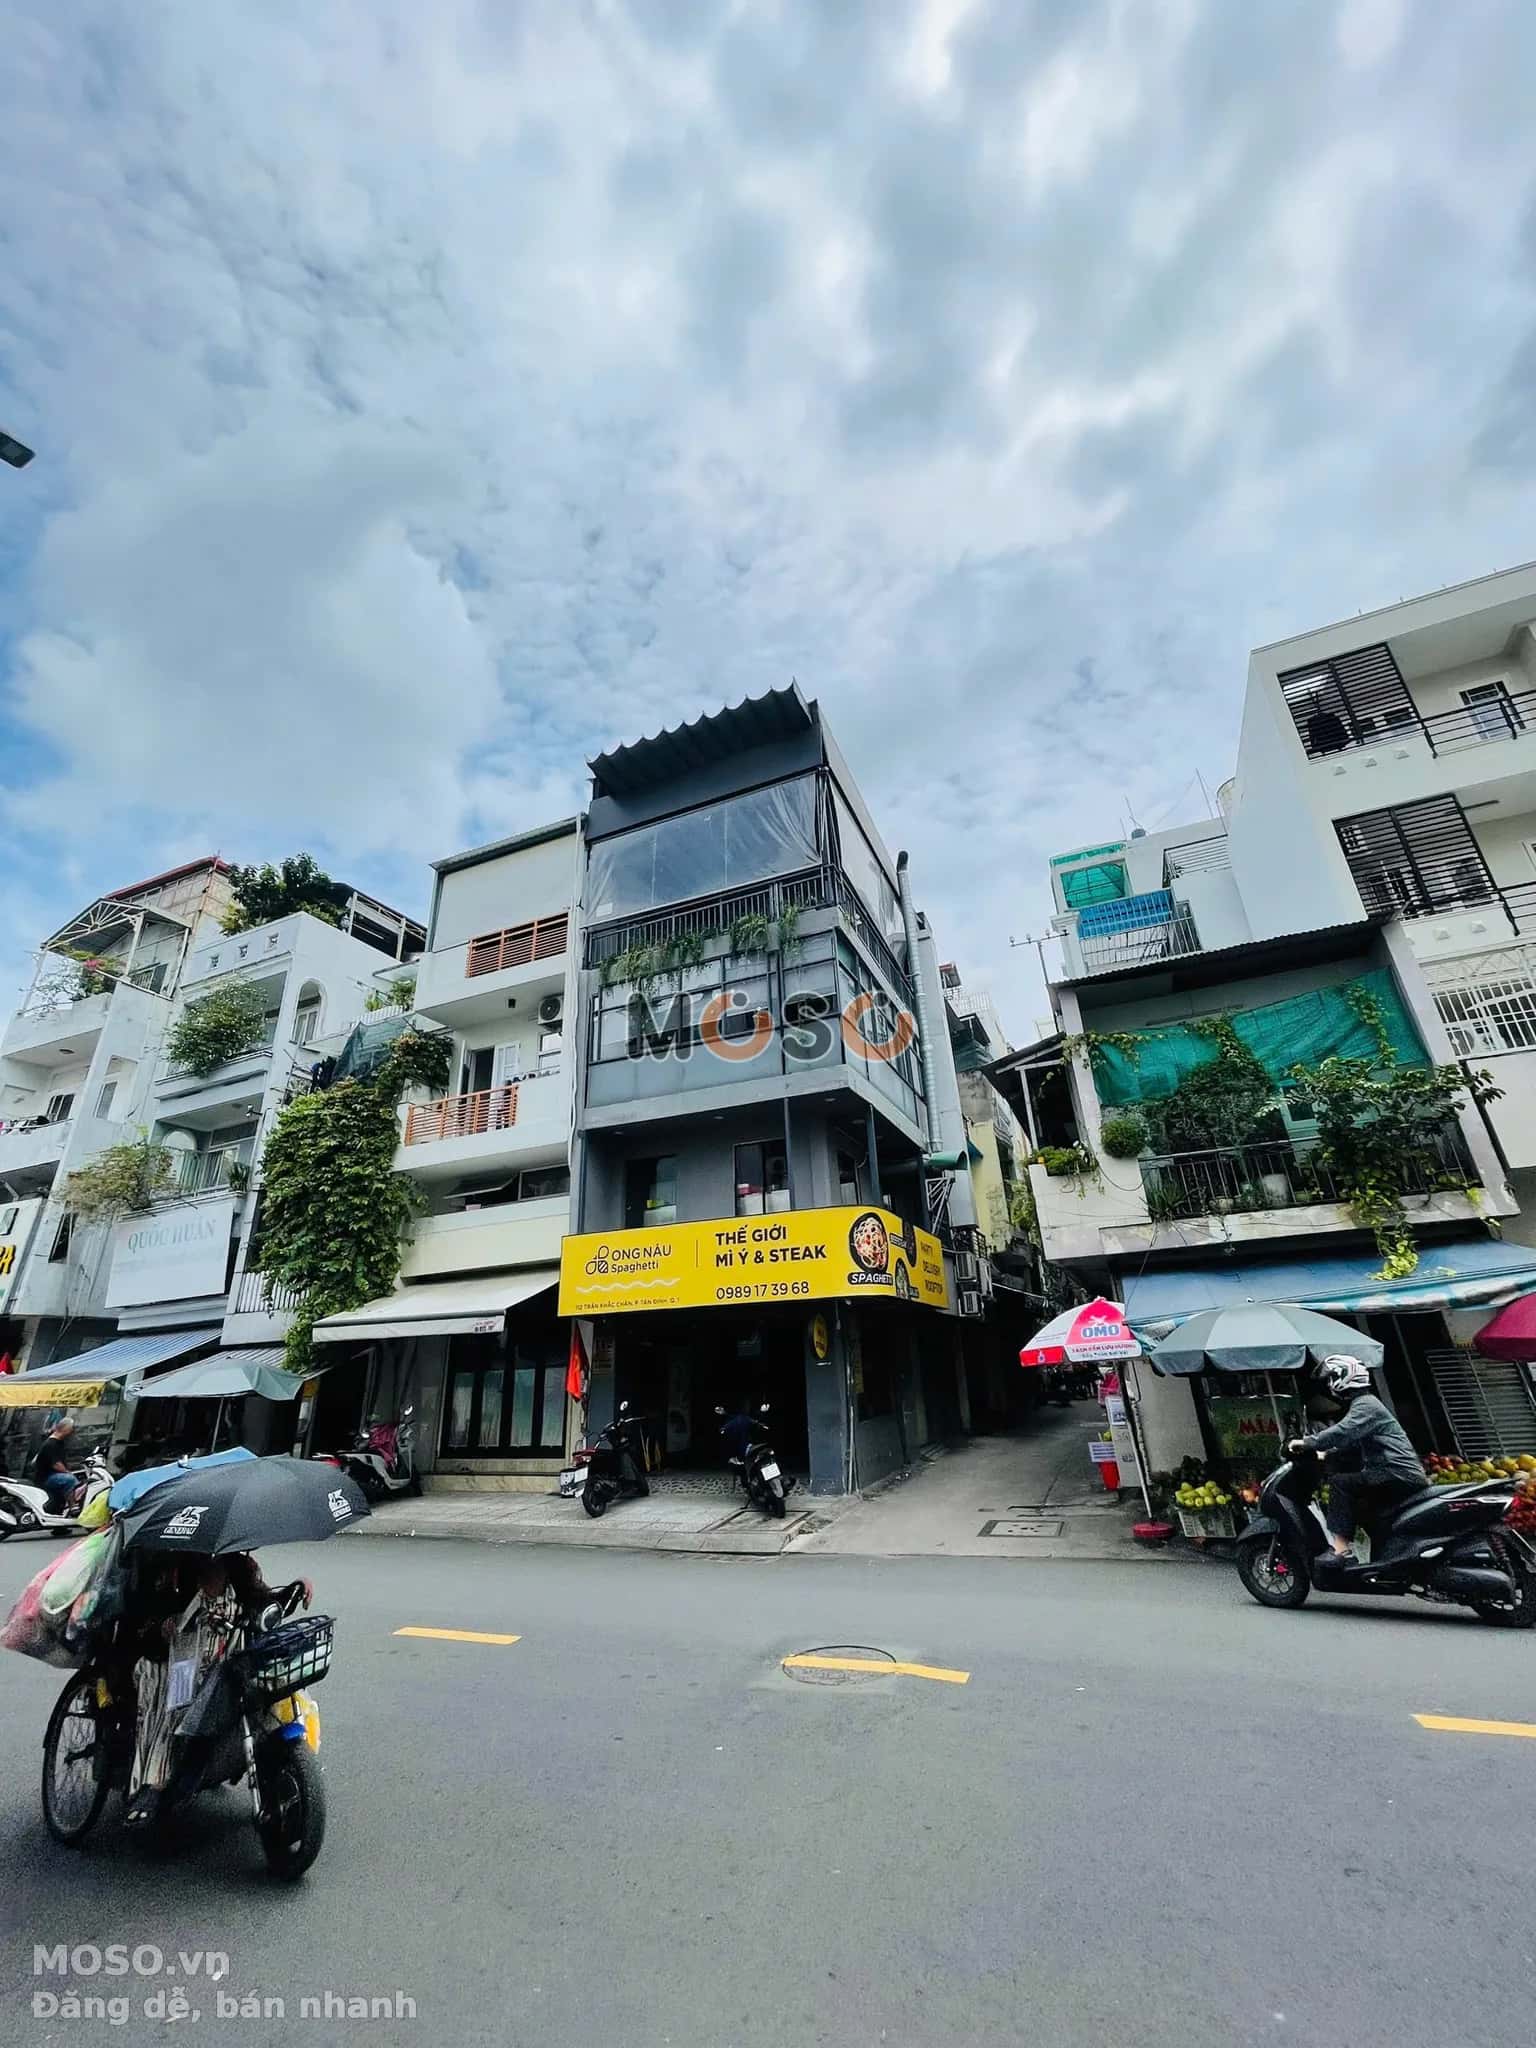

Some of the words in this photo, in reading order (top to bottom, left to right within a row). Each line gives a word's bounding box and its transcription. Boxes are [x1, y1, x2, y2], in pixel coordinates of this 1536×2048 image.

[715, 1224, 748, 1246] THẾ
[751, 1223, 787, 1242] GIỚI
[611, 1247, 641, 1261] ONG
[715, 1249, 733, 1267] MÌ
[738, 1248, 748, 1265] Ý
[753, 1250, 764, 1264] &
[769, 1244, 827, 1262] STEAK
[610, 1260, 659, 1274] Spaghetti
[716, 1285, 752, 1300] 0989
[754, 1284, 768, 1297] 17
[771, 1282, 788, 1296] 39
[791, 1281, 810, 1294] 68
[1082, 1324, 1120, 1339] OMO
